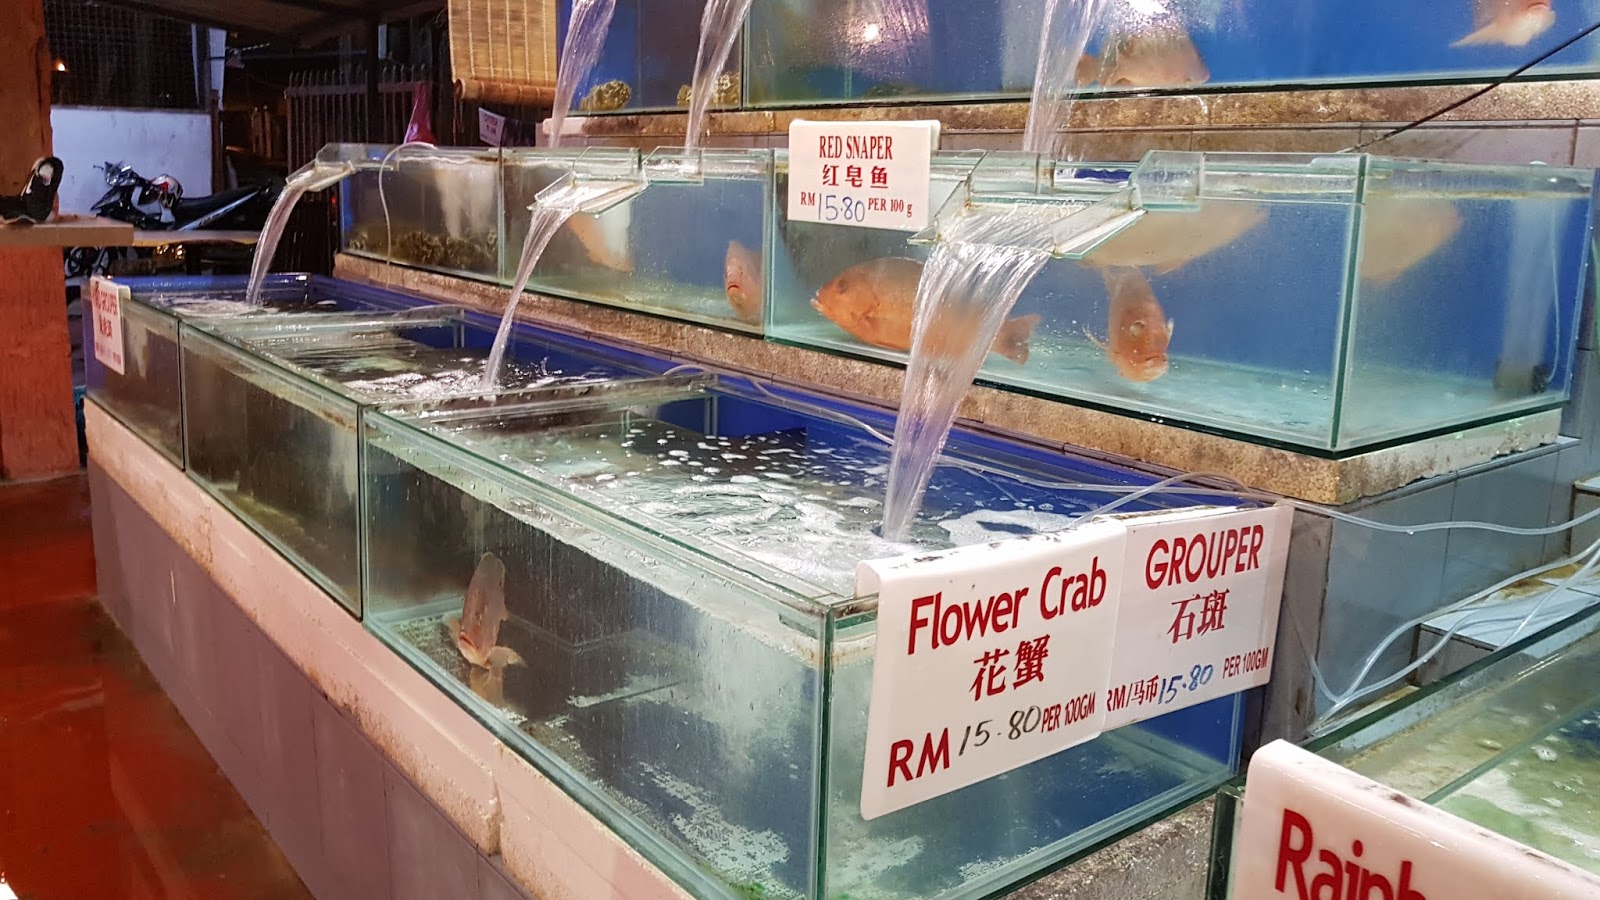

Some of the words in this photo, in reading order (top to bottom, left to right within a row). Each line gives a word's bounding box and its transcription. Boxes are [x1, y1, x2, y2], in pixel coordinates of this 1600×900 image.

[819, 136, 842, 159] RED
[846, 136, 893, 160] SNAPER
[823, 164, 889, 188] 红皂鱼
[800, 192, 815, 206] RM
[868, 198, 887, 211] PER
[890, 200, 904, 212] 100
[907, 204, 913, 217] g
[1145, 524, 1264, 590] GROUPER
[907, 588, 1029, 655] Flower
[1040, 556, 1107, 620] Crab
[1167, 588, 1230, 644] 石斑
[969, 634, 1050, 701] 花蟹
[1223, 655, 1241, 679] PER
[1242, 647, 1269, 674] 100GM
[887, 727, 950, 787] RM
[1041, 703, 1061, 733] PER
[1064, 691, 1096, 726] 100GM
